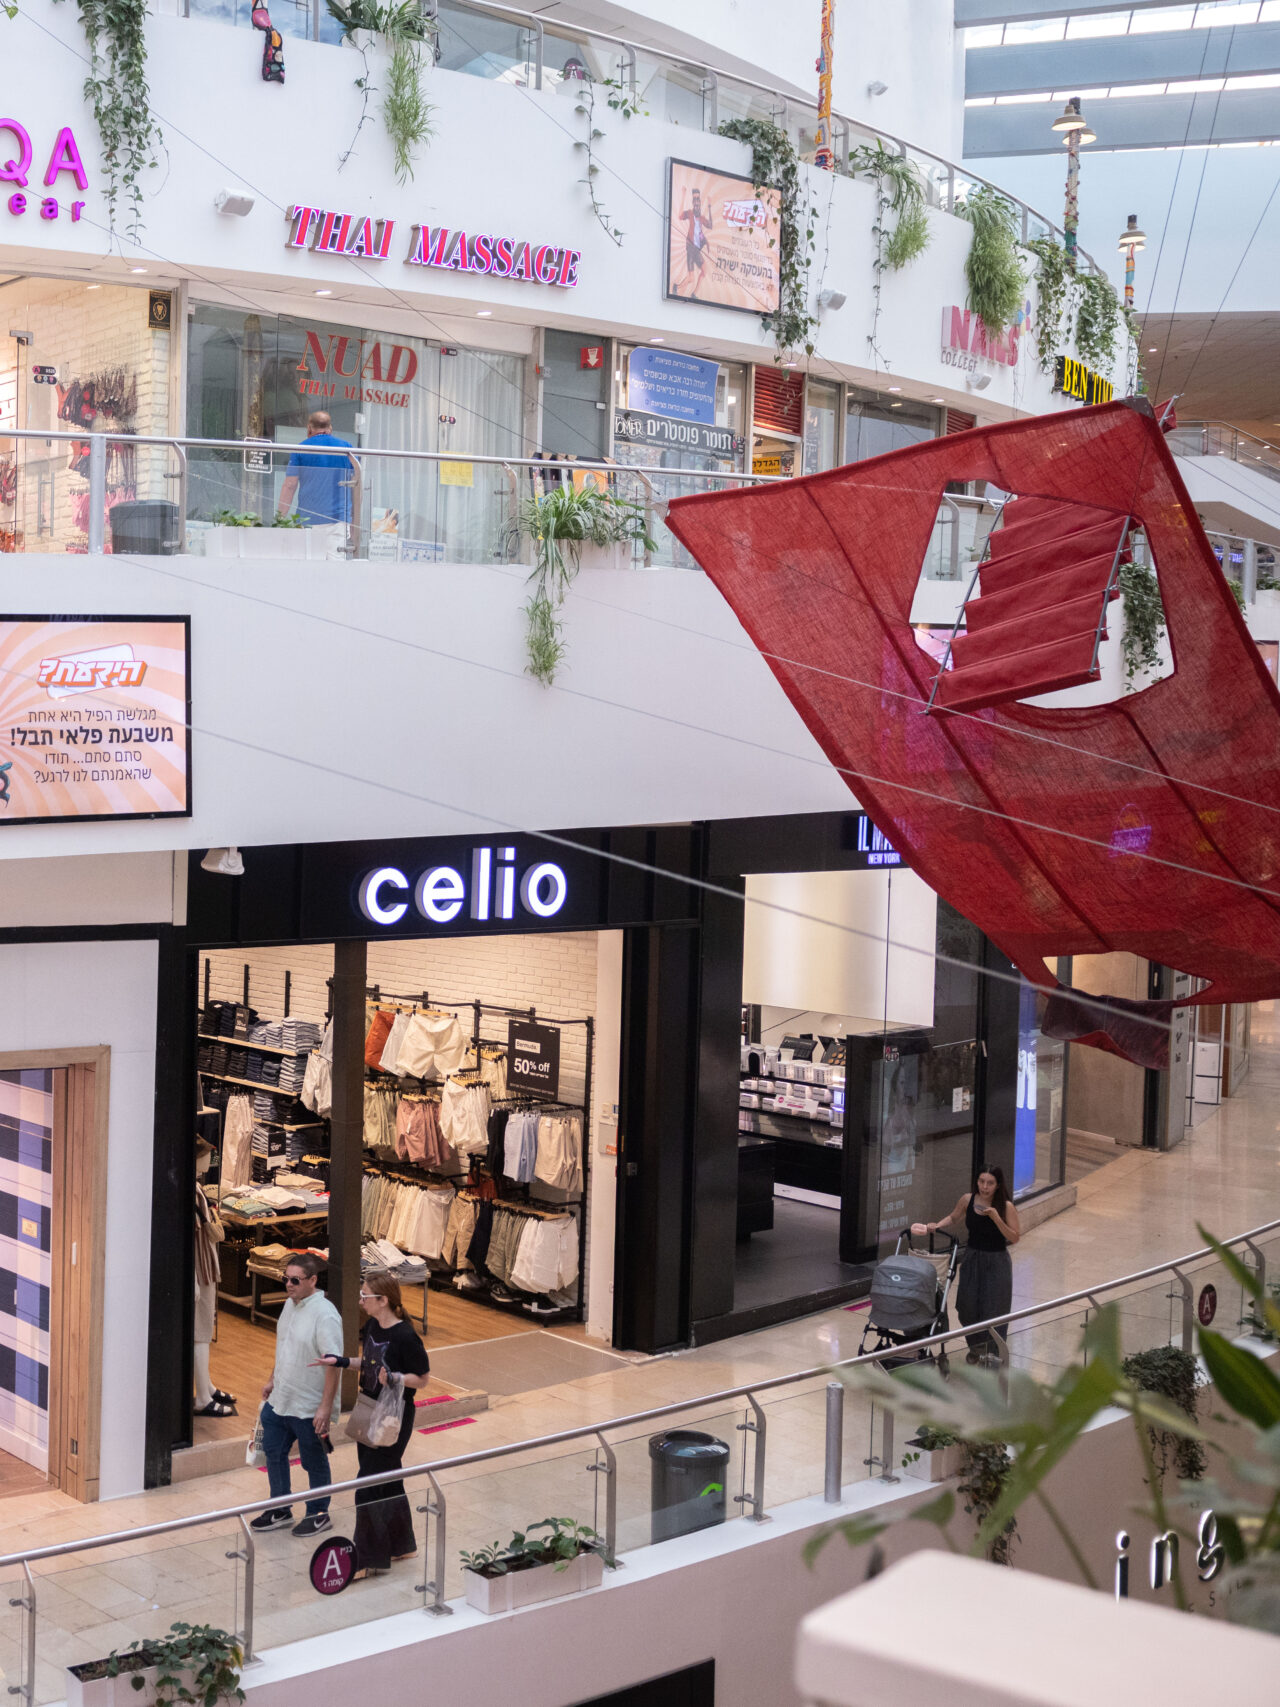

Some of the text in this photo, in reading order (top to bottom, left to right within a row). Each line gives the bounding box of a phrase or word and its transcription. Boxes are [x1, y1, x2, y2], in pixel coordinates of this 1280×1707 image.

[286, 204, 583, 290] THAI MASSAGE
[715, 257, 773, 280] בהעסקה ישירה
[296, 330, 418, 385] NUAD
[1063, 355, 1089, 401] BEN
[298, 378, 410, 409] THAI MASSAGE
[647, 419, 699, 445] פוסטרים
[702, 429, 732, 450] תומר
[37, 658, 148, 688] הידעת?
[28, 707, 157, 723] מגלשת הפיל היא אחת
[10, 726, 174, 746] משבעת פלאי תבל!
[45, 750, 142, 765] סתם סתם... תודו
[33, 768, 152, 784] שהאמנתם לנו לרגע?
[868, 853, 883, 865] NEW
[358, 846, 567, 925] celio
[513, 1058, 551, 1075] 50% off
[1202, 1293, 1211, 1315] A
[322, 1549, 342, 1579] A
[328, 1578, 344, 1587] קומה
